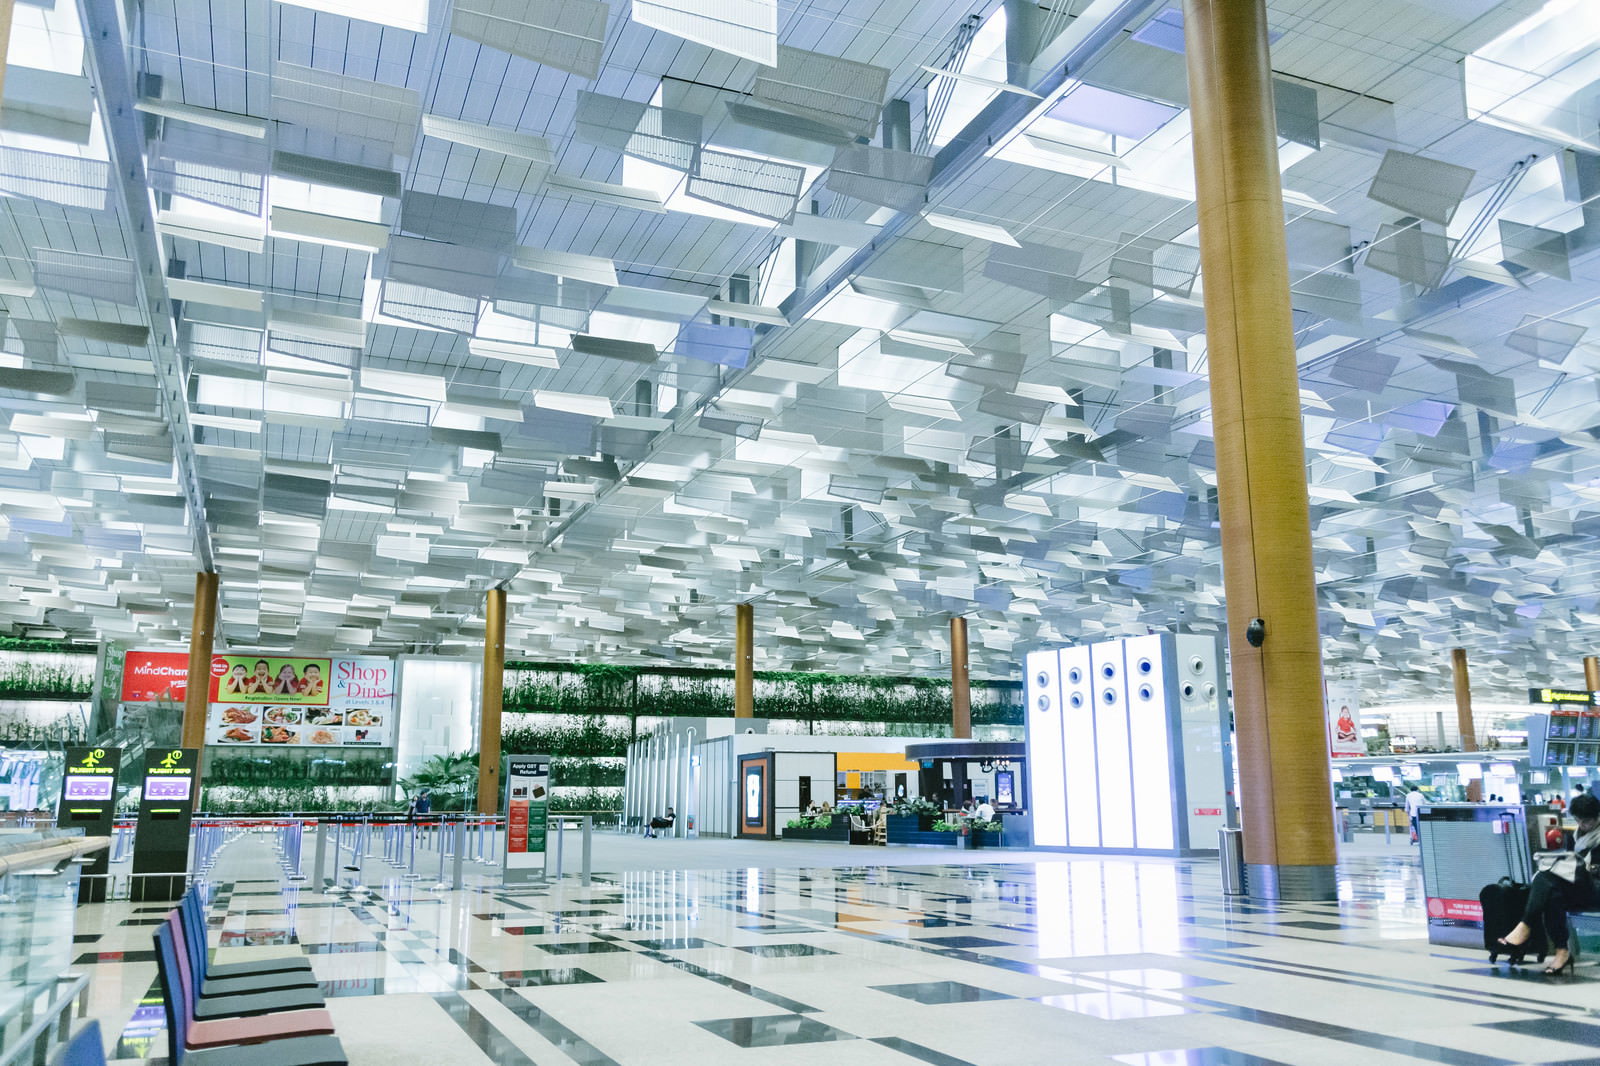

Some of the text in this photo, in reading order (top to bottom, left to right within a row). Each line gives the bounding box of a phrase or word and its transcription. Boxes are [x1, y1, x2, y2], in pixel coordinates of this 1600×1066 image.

[337, 661, 387, 686] Shop
[337, 680, 389, 698] & Dine
[69, 766, 96, 774] FLIGHT
